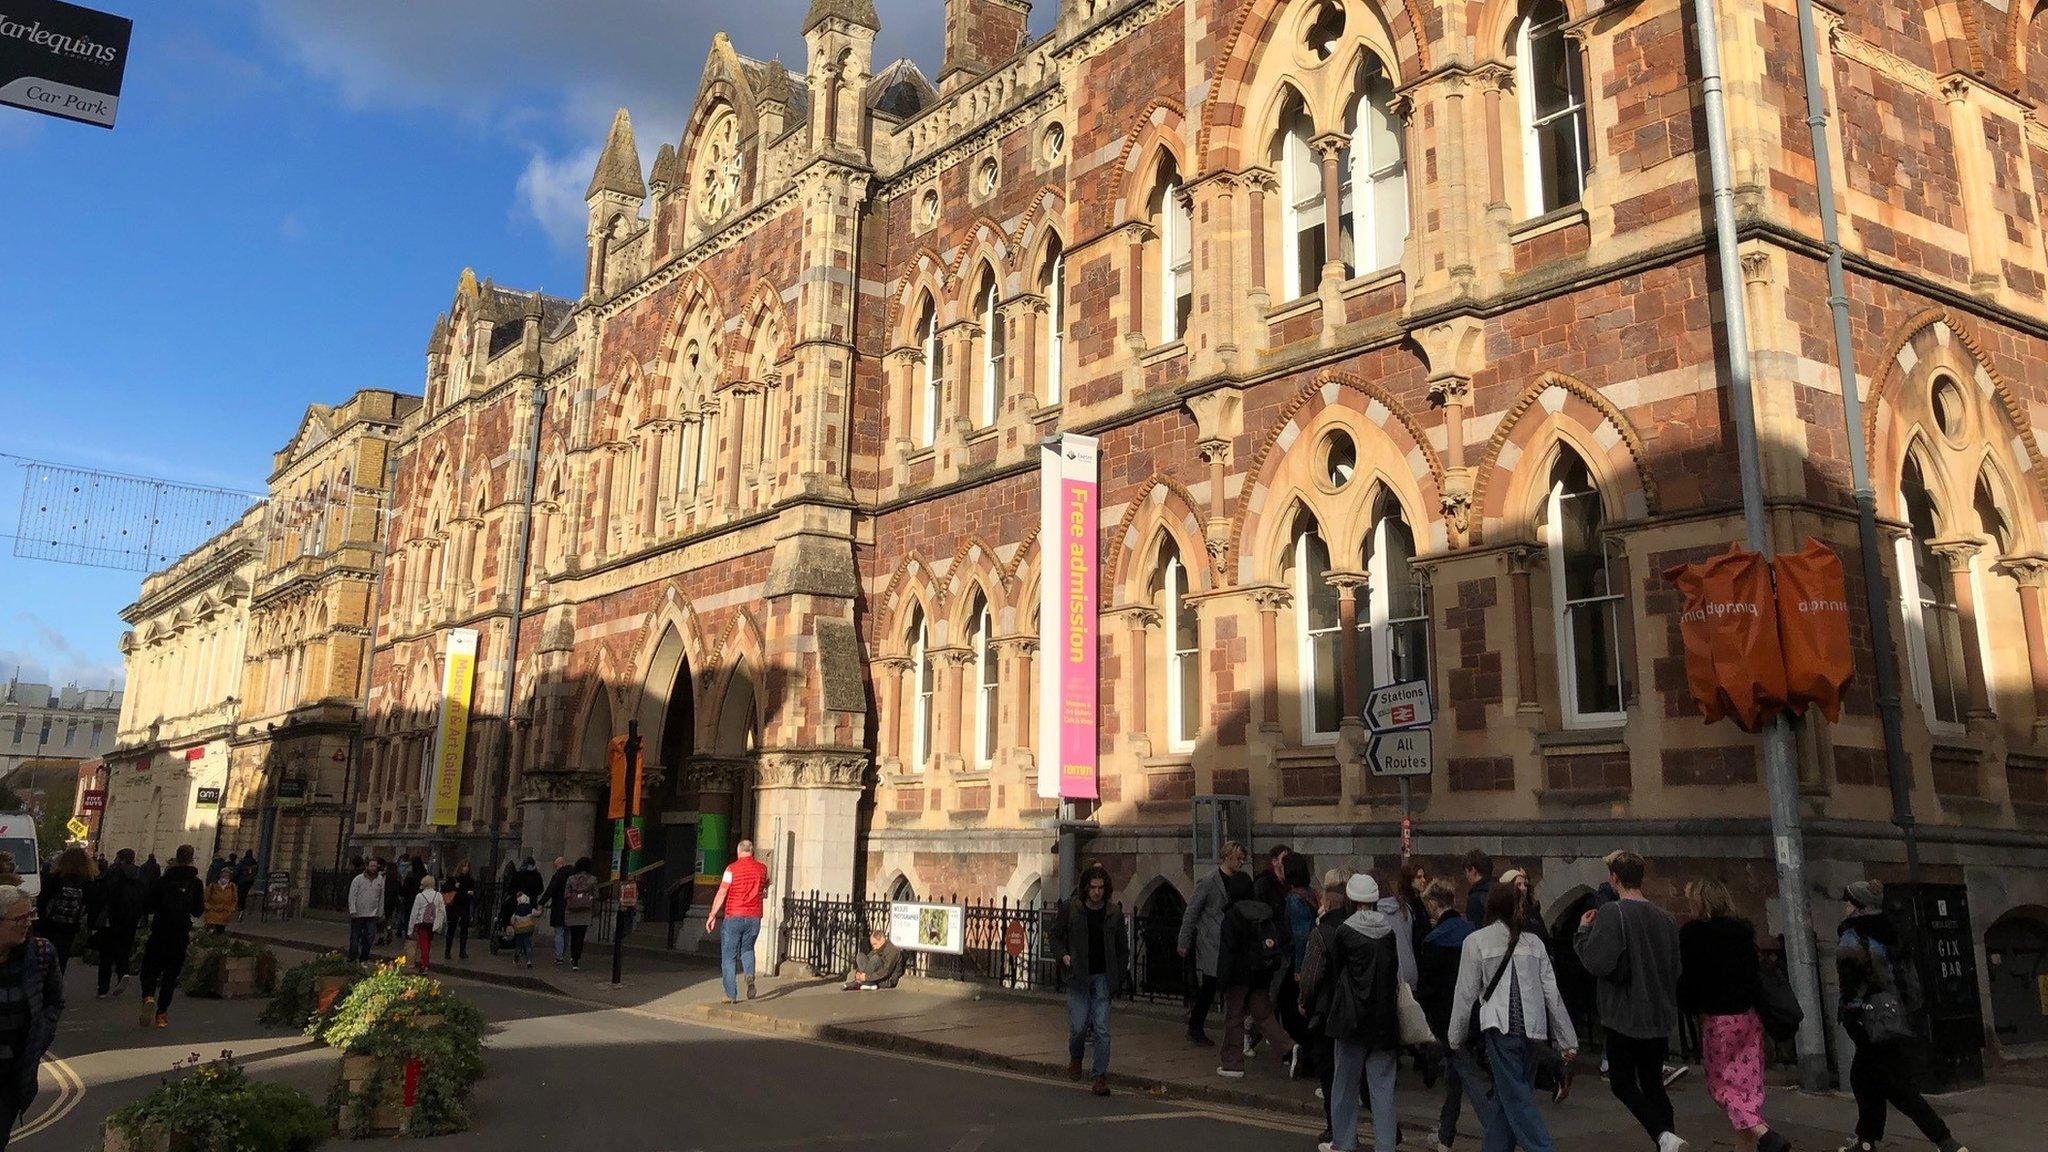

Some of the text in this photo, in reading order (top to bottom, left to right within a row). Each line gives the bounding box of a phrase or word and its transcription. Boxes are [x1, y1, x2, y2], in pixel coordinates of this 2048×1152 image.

[26, 85, 108, 116] Car Park
[1070, 487, 1088, 538] Free
[1069, 543, 1089, 663] admission
[451, 658, 468, 713] Museum
[1380, 688, 1424, 704] Stations
[448, 728, 460, 750] Art
[1397, 738, 1414, 751] All
[1385, 755, 1427, 769] Routes
[439, 752, 458, 800] Gallery
[1941, 962, 1962, 978] BAR
